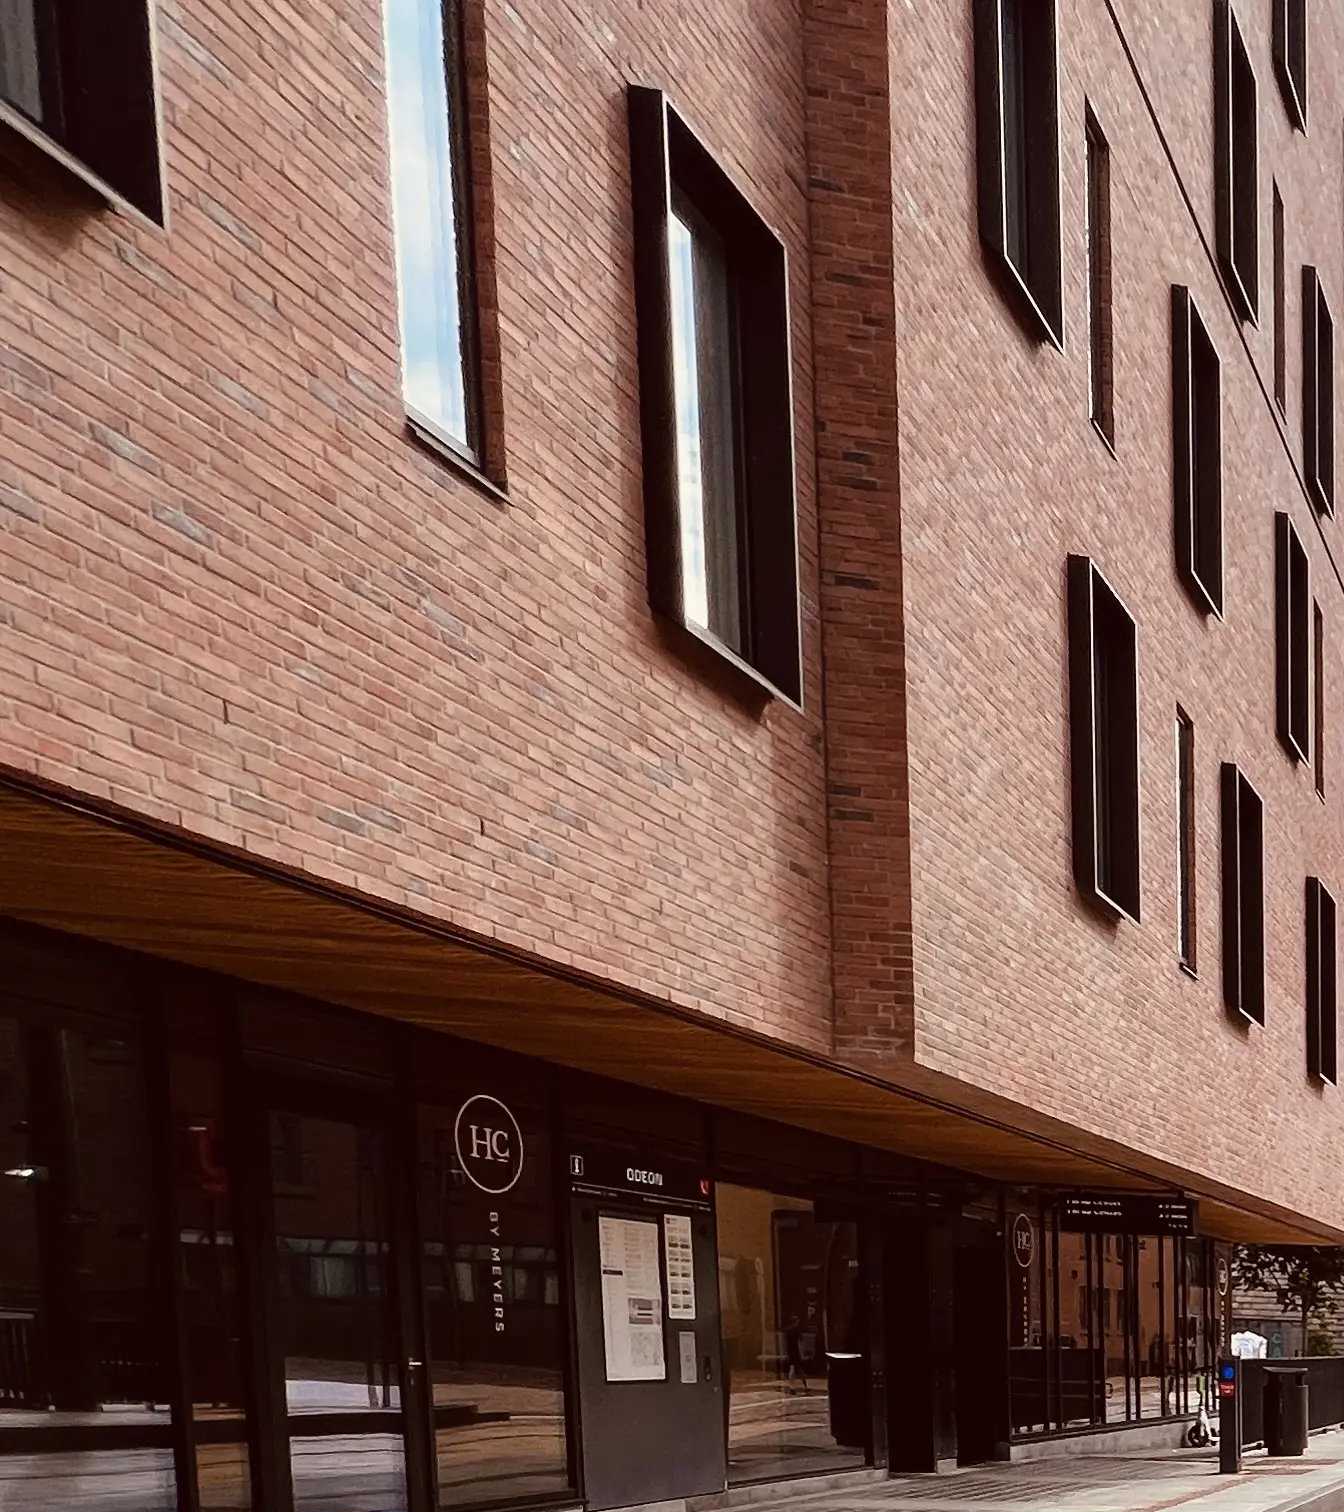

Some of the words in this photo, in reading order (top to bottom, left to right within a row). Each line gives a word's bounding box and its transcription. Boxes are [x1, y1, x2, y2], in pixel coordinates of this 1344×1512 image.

[626, 1167, 663, 1186] ODEON
[489, 1212, 500, 1237] BY
[490, 1247, 505, 1332] MEYERS
